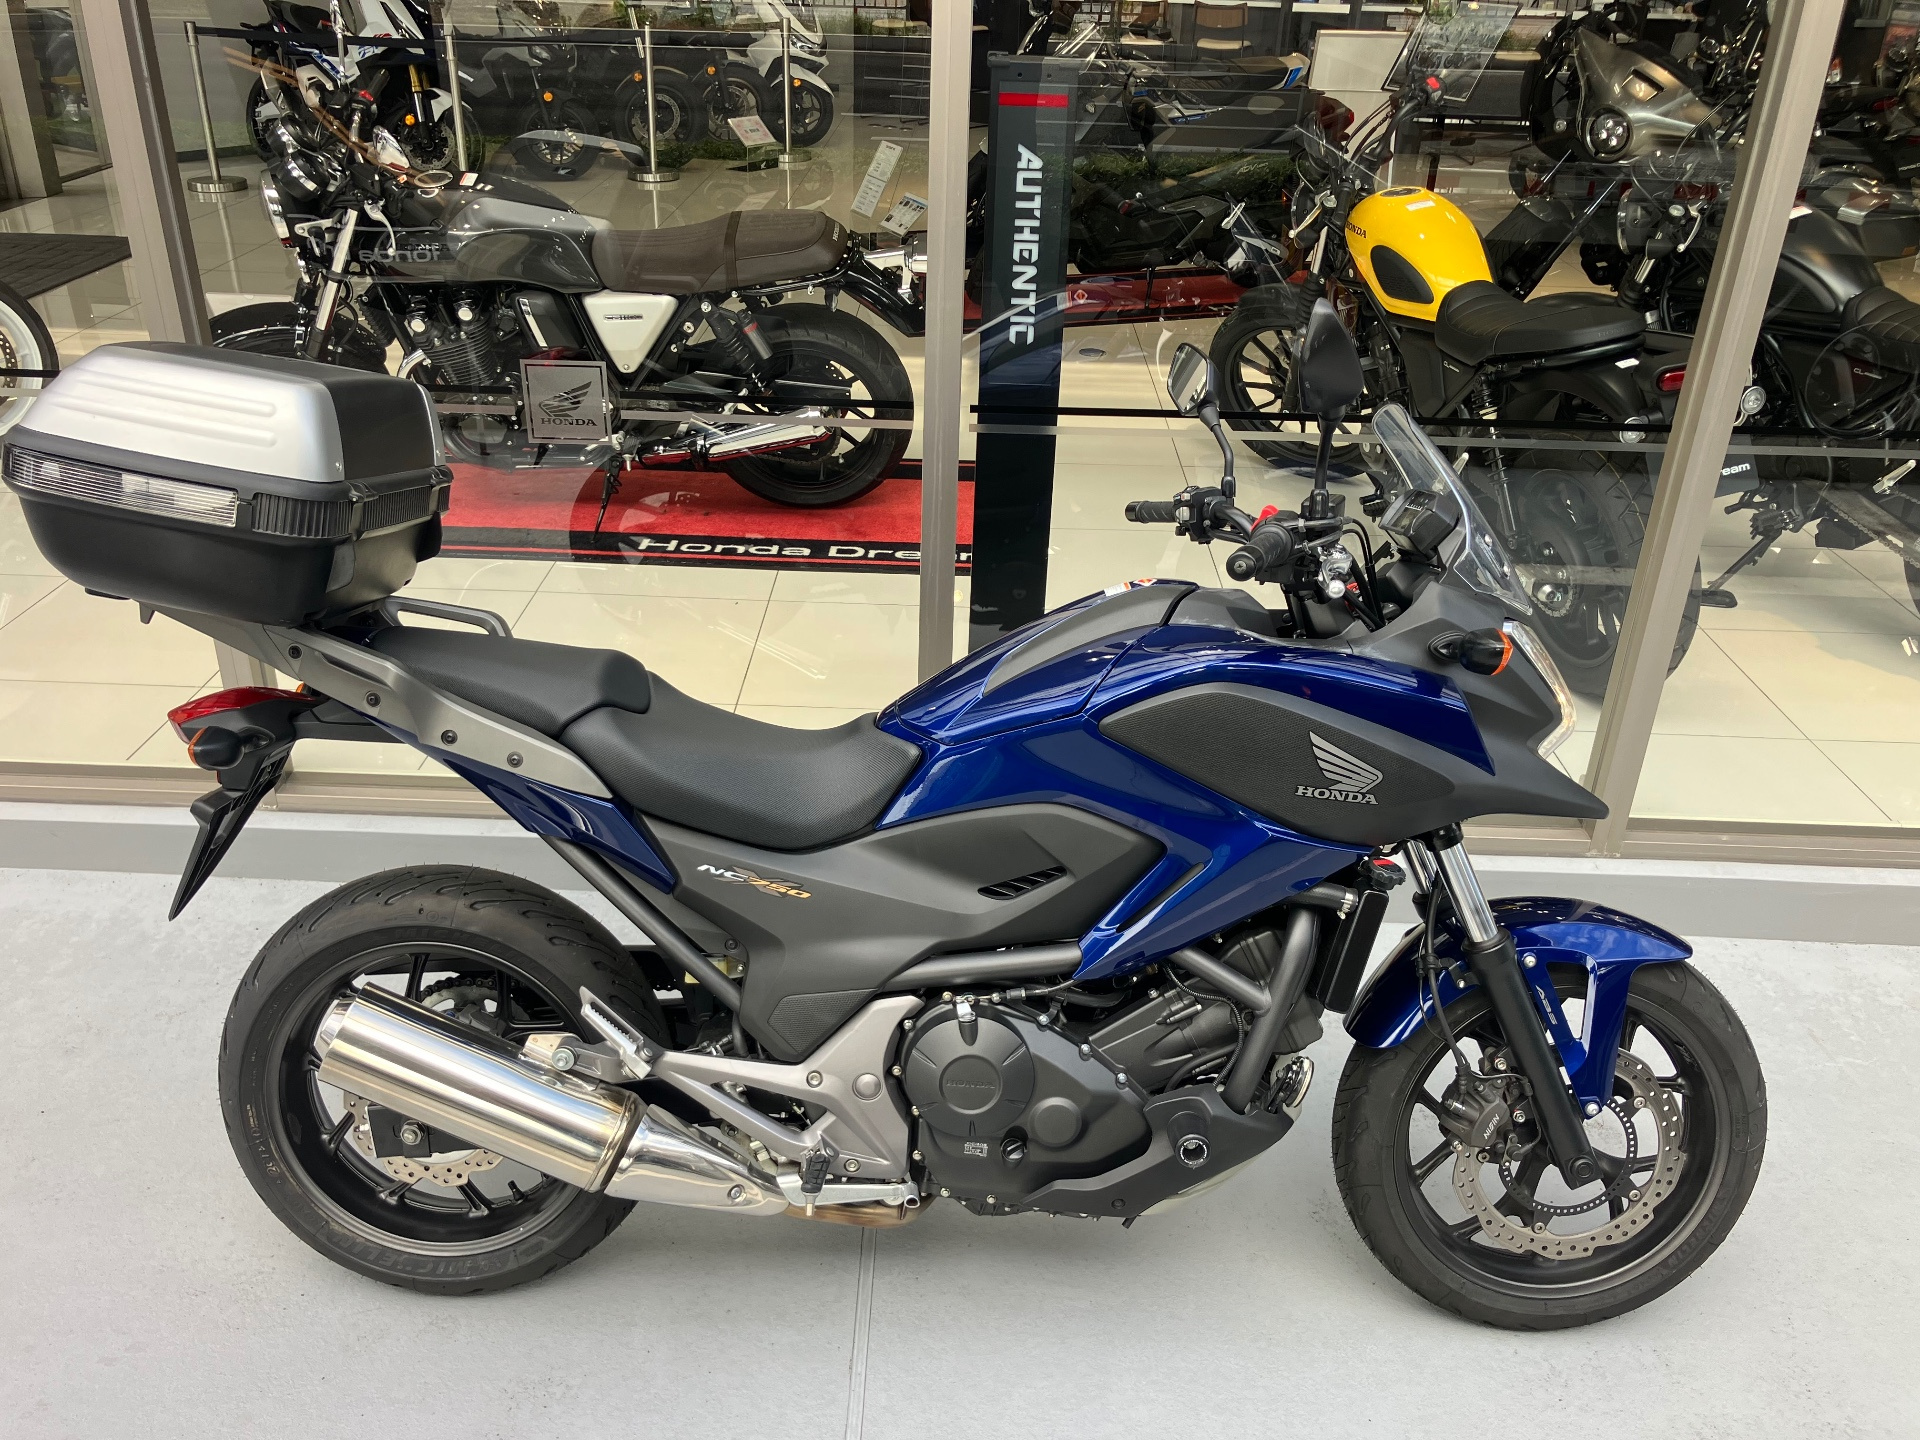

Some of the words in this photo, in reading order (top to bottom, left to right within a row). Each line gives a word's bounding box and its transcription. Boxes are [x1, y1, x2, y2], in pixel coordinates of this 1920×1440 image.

[1008, 143, 1044, 345] AUTHENTIC
[540, 418, 598, 427] HONDA
[638, 538, 810, 556] Honda
[1295, 785, 1379, 805] HONDA
[1535, 984, 1558, 1025] ABS
